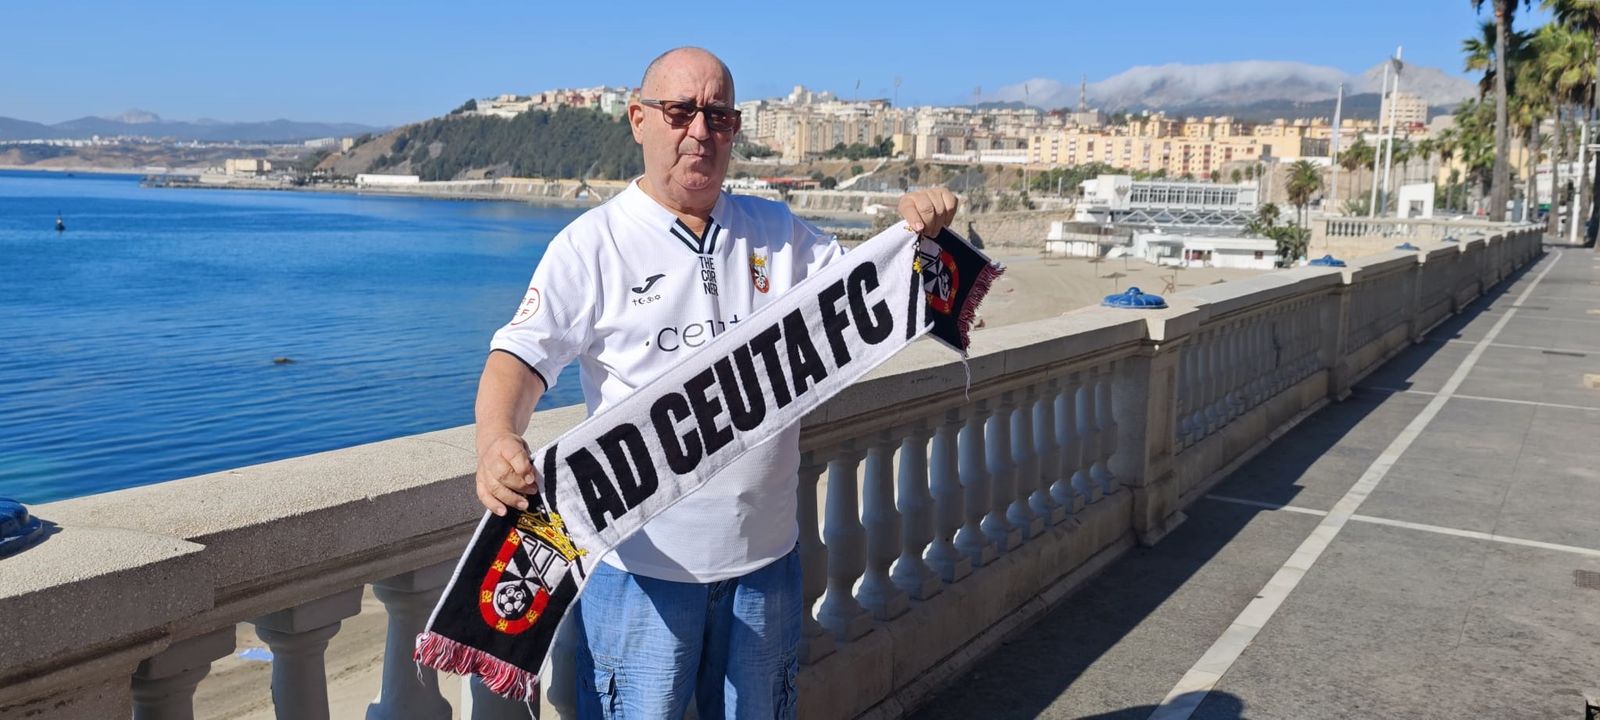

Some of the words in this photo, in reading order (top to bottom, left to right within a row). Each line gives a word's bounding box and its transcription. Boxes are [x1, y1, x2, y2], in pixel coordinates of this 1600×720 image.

[698, 256, 716, 270] THE
[701, 269, 717, 283] COR
[703, 282, 719, 297] NER
[565, 423, 659, 532] AD
[650, 308, 828, 475] CEUTA
[817, 261, 894, 369] FC
